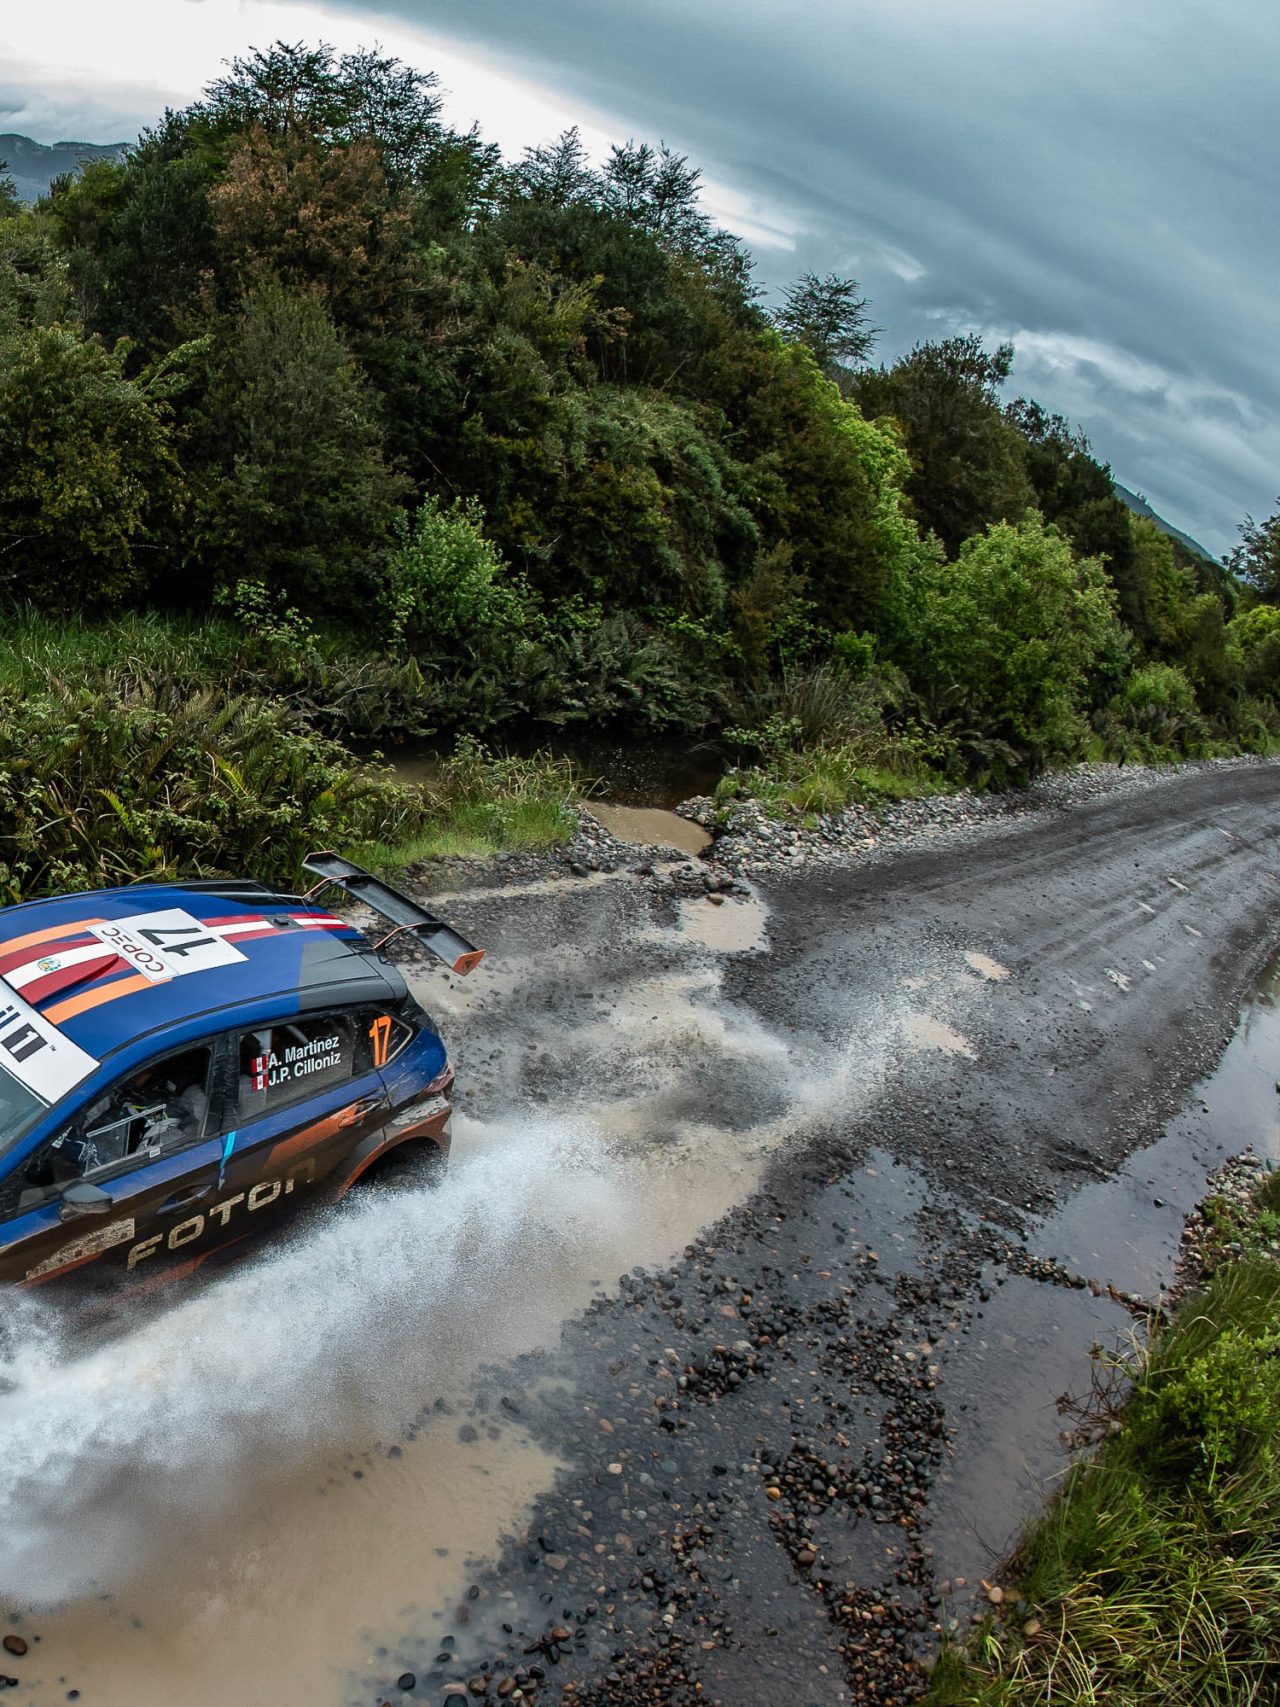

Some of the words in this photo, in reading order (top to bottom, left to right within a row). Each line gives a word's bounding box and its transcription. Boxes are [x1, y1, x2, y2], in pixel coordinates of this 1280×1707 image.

[101, 927, 164, 972] COPEC
[136, 928, 217, 956] 17
[268, 1054, 282, 1069] A.
[285, 1035, 340, 1063] Martinez
[369, 1014, 391, 1067] 17
[268, 1067, 291, 1086] J.P.
[294, 1051, 341, 1077] Cilloniz
